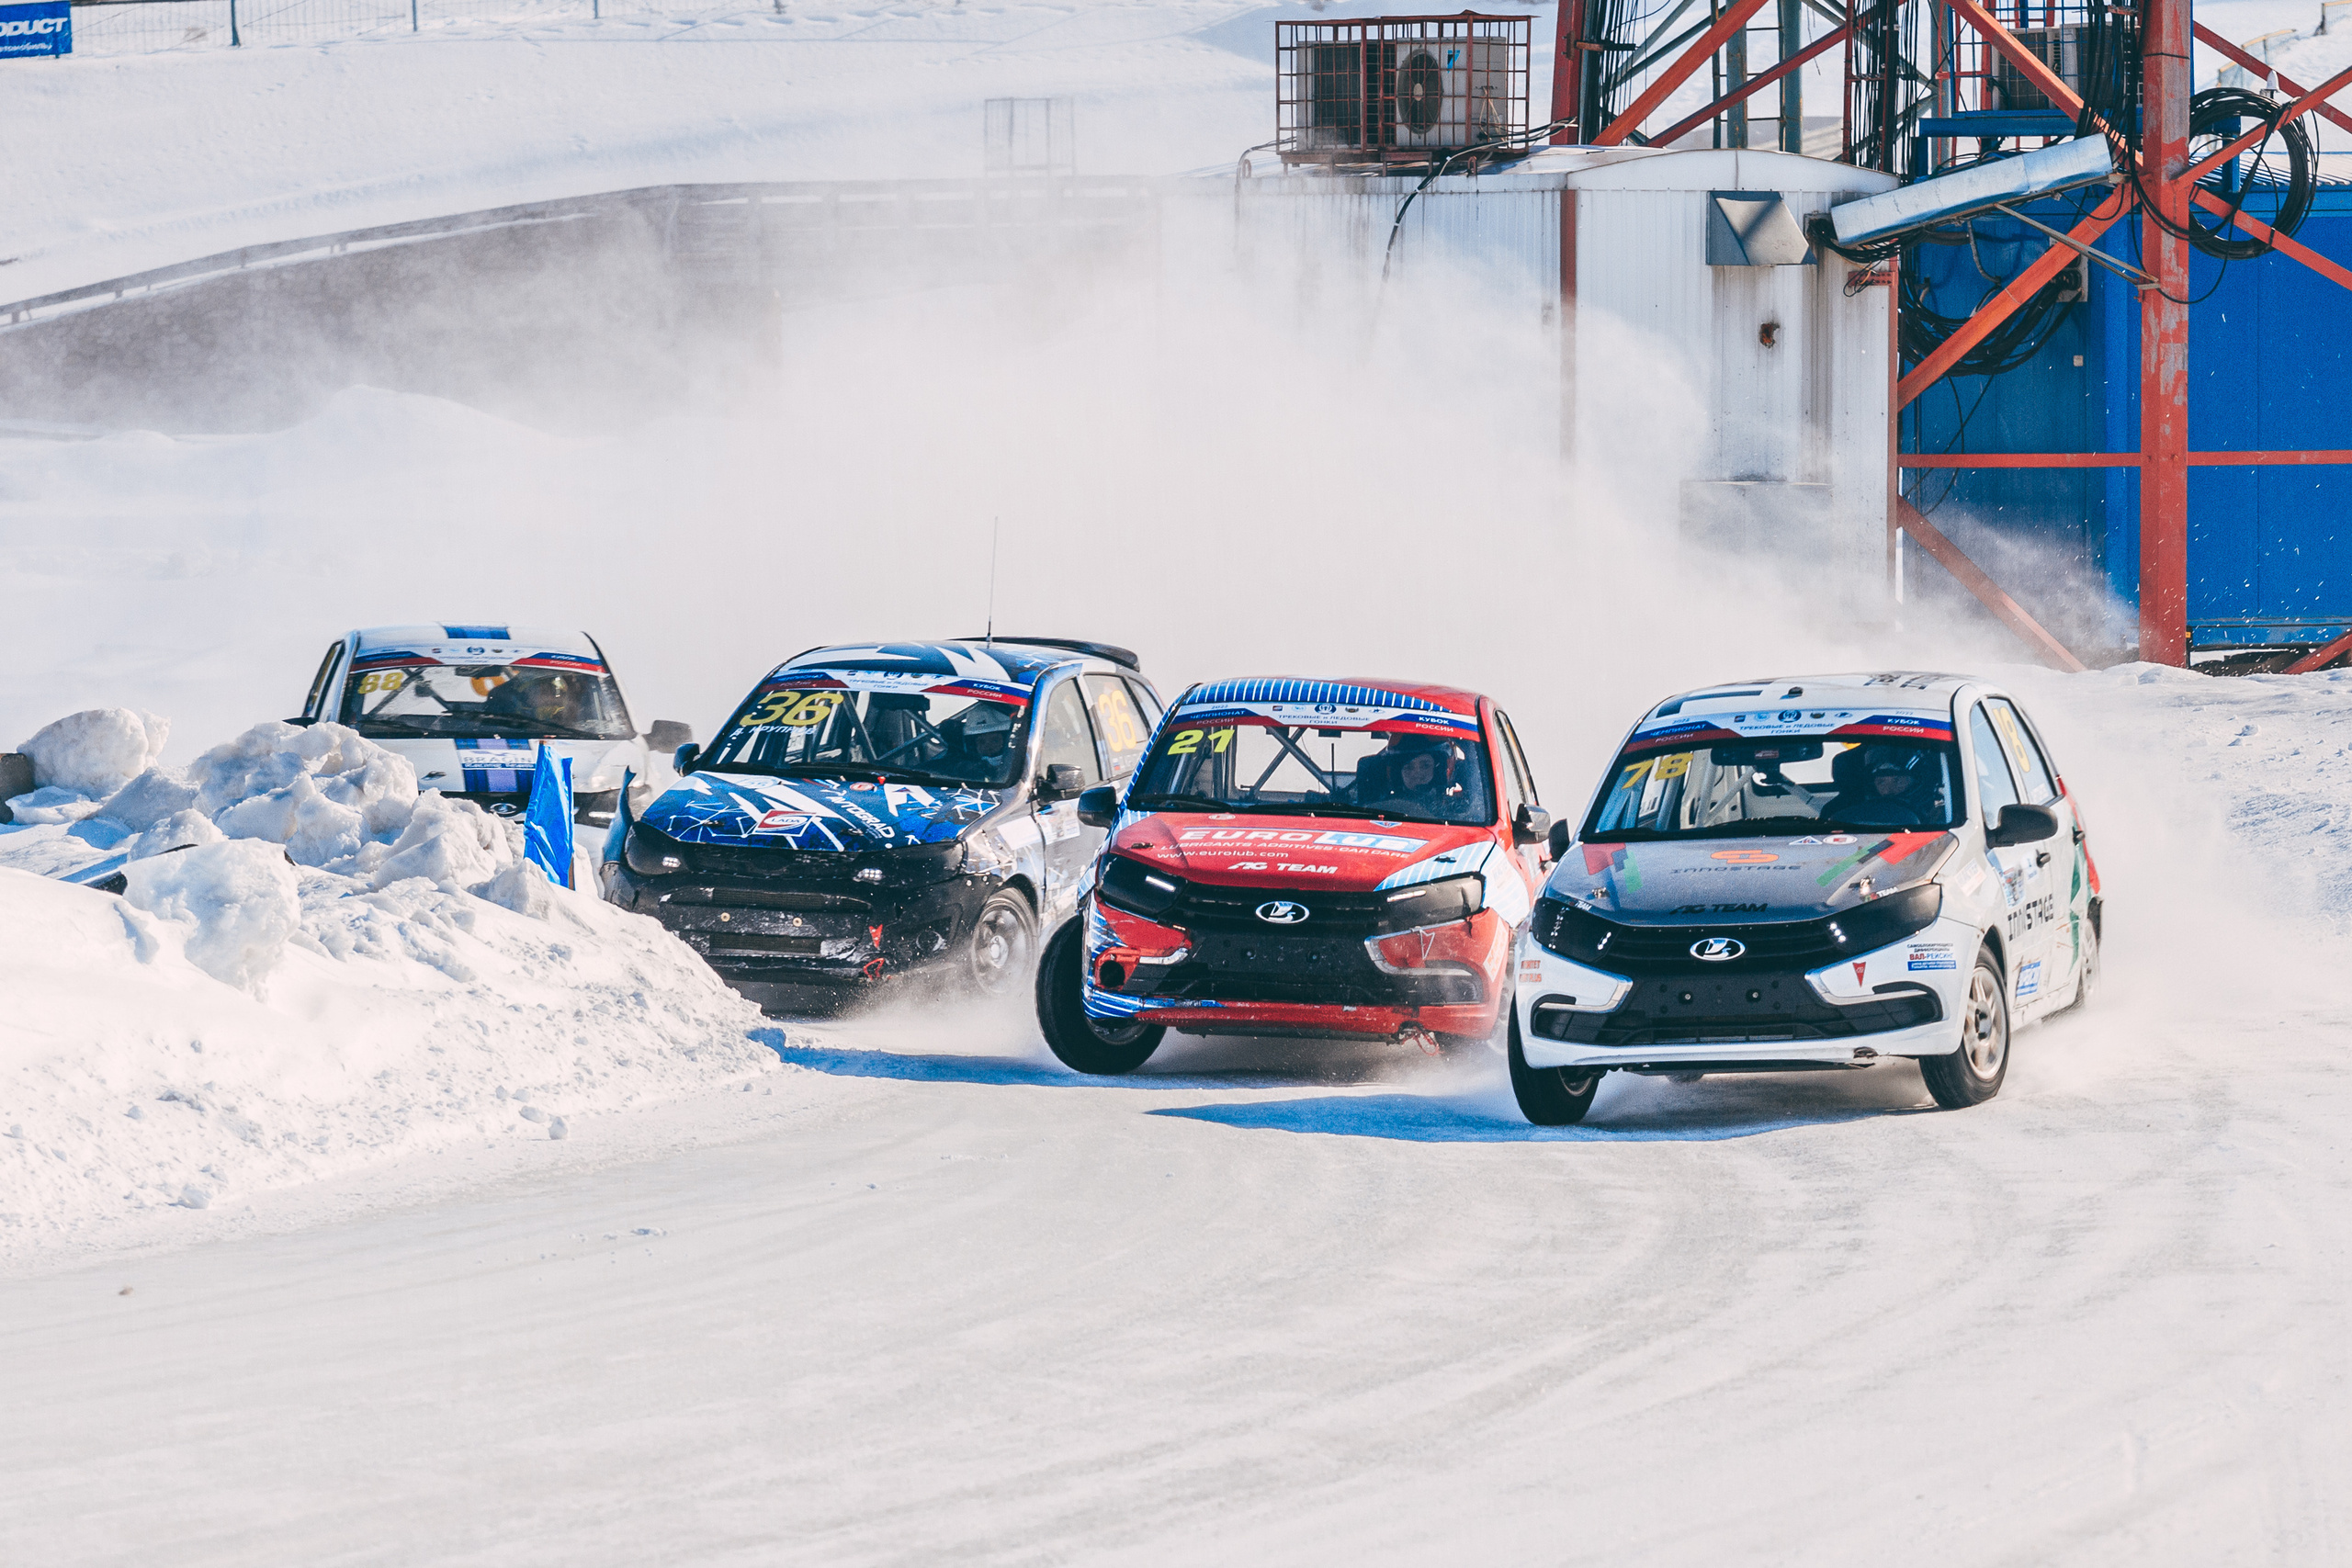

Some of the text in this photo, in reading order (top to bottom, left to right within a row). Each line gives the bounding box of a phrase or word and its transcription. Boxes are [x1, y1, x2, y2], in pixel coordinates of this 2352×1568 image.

[357, 671, 404, 694] 88
[973, 682, 1001, 691] КУБОК
[967, 689, 1002, 698] РОССИИ
[739, 691, 844, 727] 36
[1190, 710, 1246, 719] ЧЕМПИОНАТ
[1098, 689, 1136, 752] 36
[1419, 716, 1449, 725] КУБОК
[1887, 717, 1920, 726] КУБОК
[1416, 723, 1453, 732] РОССИИ
[1650, 724, 1706, 736] ЧЕМПИОНАТ
[1883, 725, 1925, 734] РОССИИ
[1167, 729, 1235, 755] 21
[1655, 733, 1694, 742] РОССИИ
[1622, 752, 1693, 790] 78
[1158, 850, 1289, 859] www.eurolub.com
[1161, 841, 1252, 851] LUBRICANTS
[1258, 842, 1336, 851] ADDITIVES
[1373, 850, 1410, 859] CARE
[1276, 863, 1339, 874] TEAM
[1712, 902, 1769, 913] TEAM
